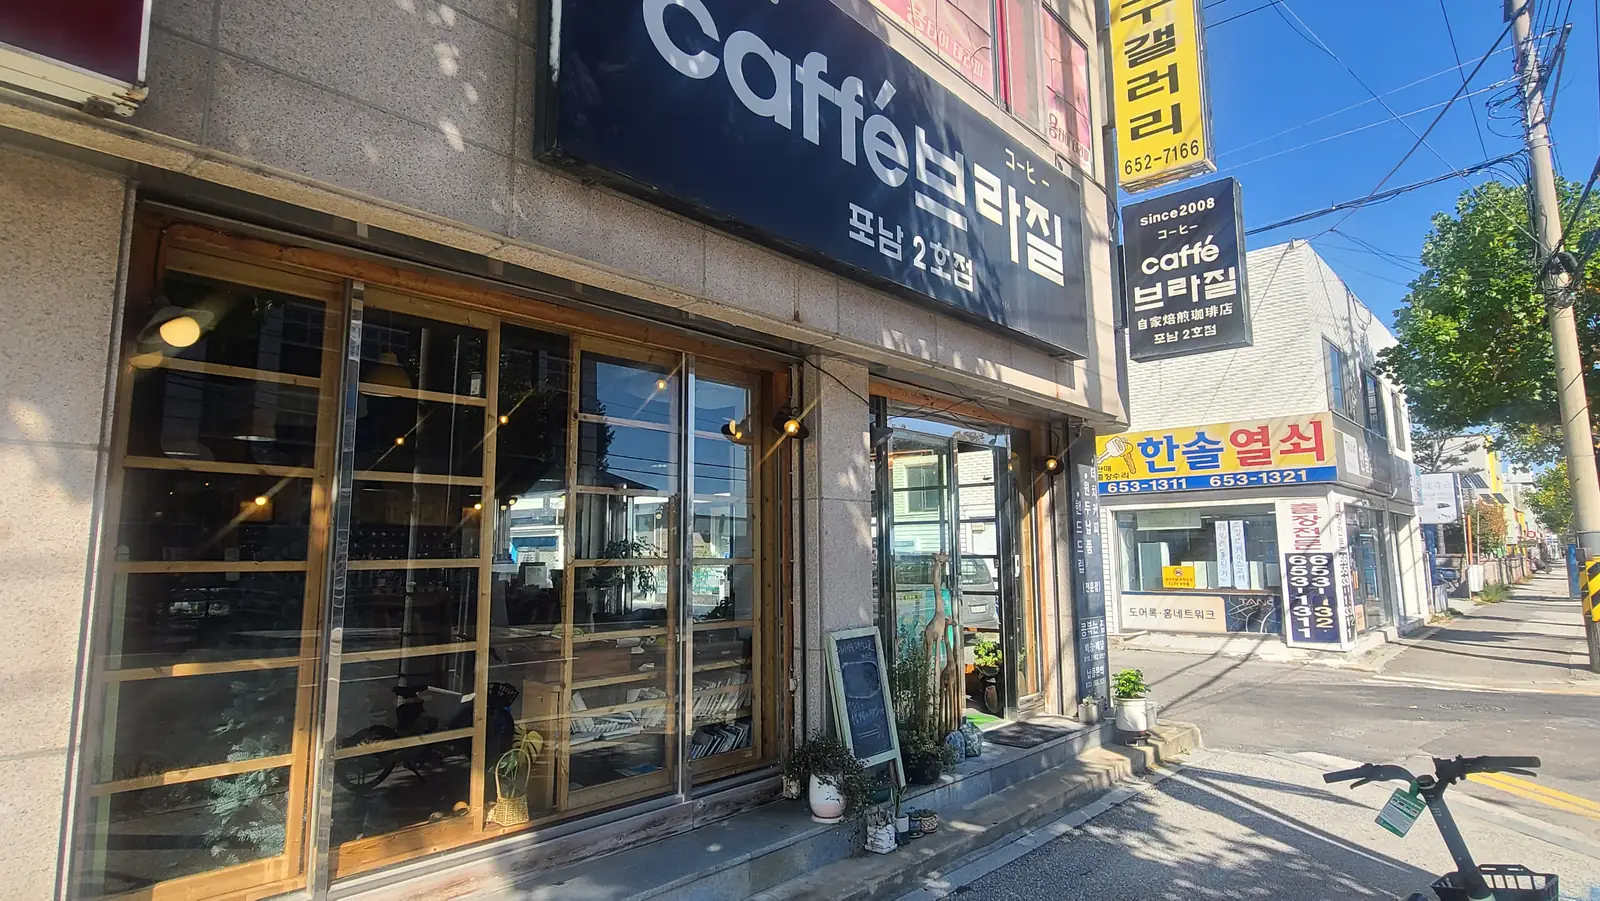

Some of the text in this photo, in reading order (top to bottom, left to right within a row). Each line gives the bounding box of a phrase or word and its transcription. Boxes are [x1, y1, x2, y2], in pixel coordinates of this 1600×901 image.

[643, 0, 910, 188] caffé
[1005, 148, 1050, 187] コーヒー
[1124, 139, 1199, 175] 652-7166
[915, 123, 1065, 287] 브라질
[849, 202, 974, 293] 포남 2호점
[1157, 224, 1198, 240] コーヒー
[1141, 234, 1220, 275] caffé
[1134, 266, 1237, 312] 브라질
[1137, 302, 1233, 331] 自家焙煎珈琲店
[1154, 324, 1217, 345] 포남 2호점
[1137, 431, 1224, 473] 한솔
[1229, 420, 1326, 469] 열쇠
[1107, 469, 1307, 493] 653-1311 653-1321
[1291, 503, 1322, 550] 출장전문
